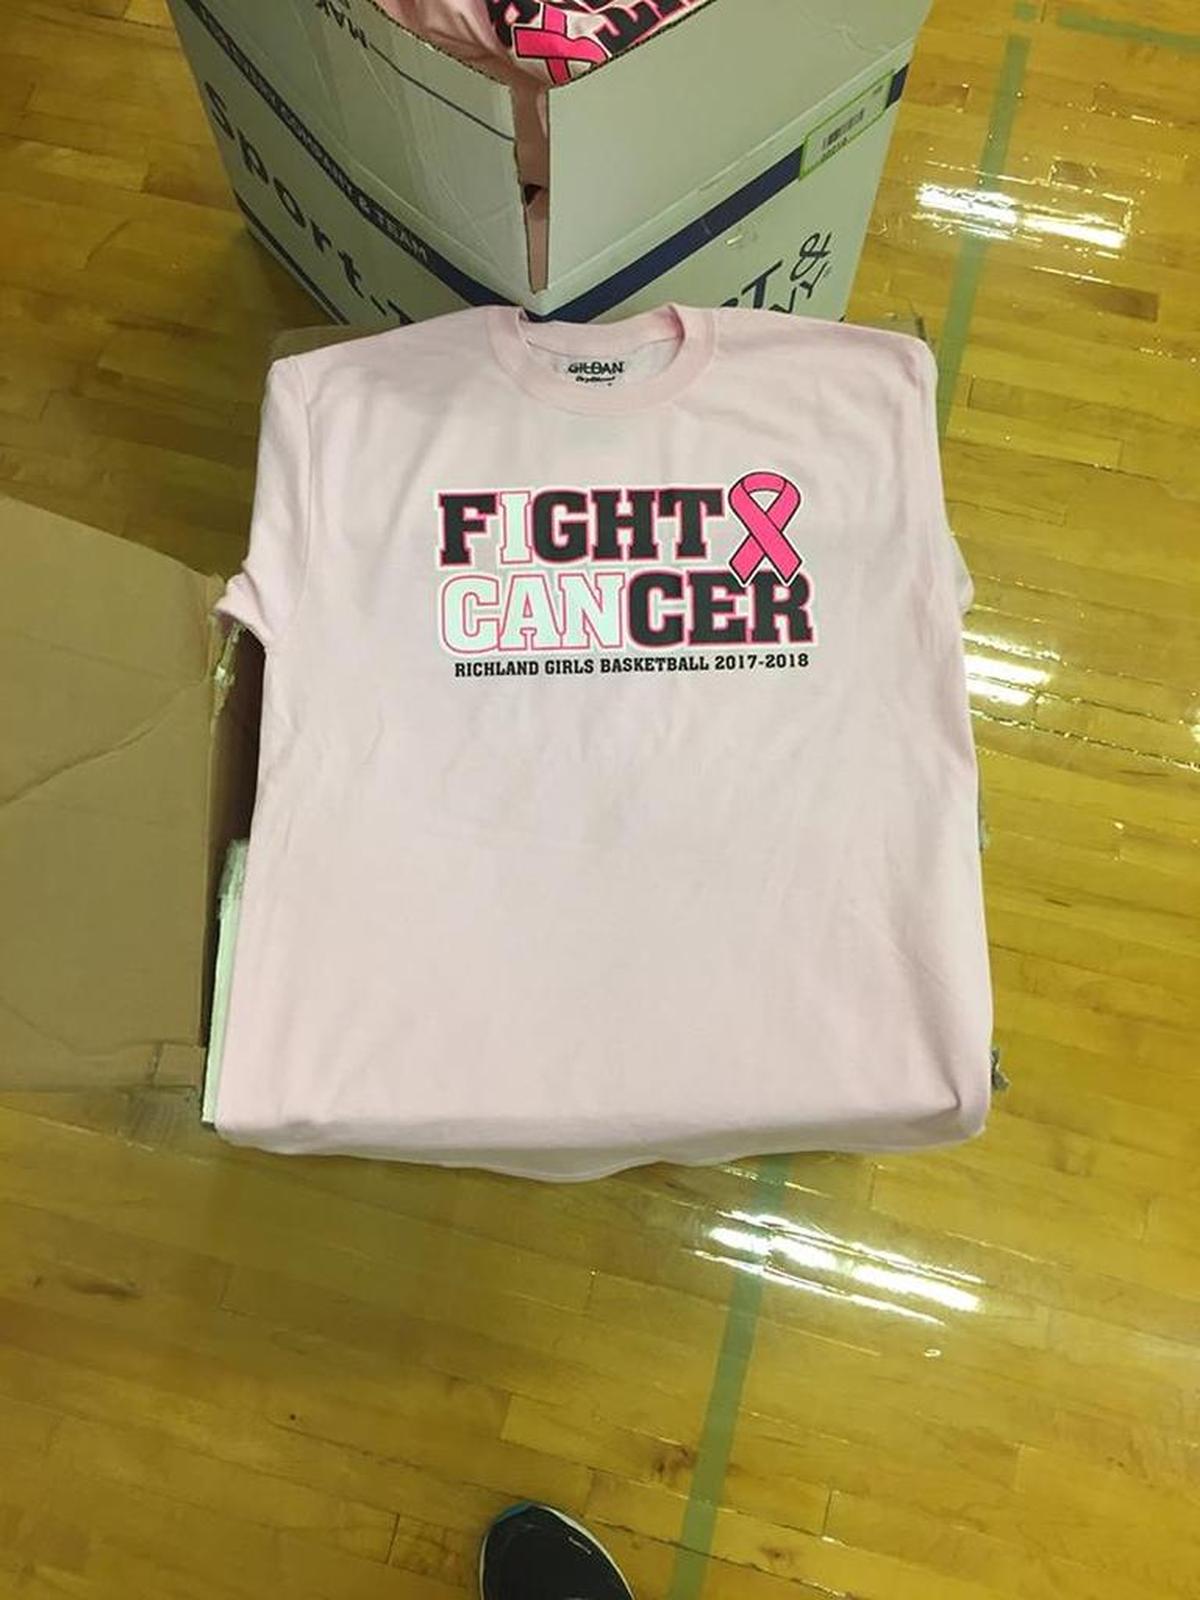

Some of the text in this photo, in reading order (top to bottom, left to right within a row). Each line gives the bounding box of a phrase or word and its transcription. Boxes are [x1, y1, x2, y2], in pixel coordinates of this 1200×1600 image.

[438, 488, 724, 567] FIGHT
[442, 570, 814, 653] CANCER
[454, 653, 809, 678] RICHLAND GIRLS BASKETBALL 2017-2018
